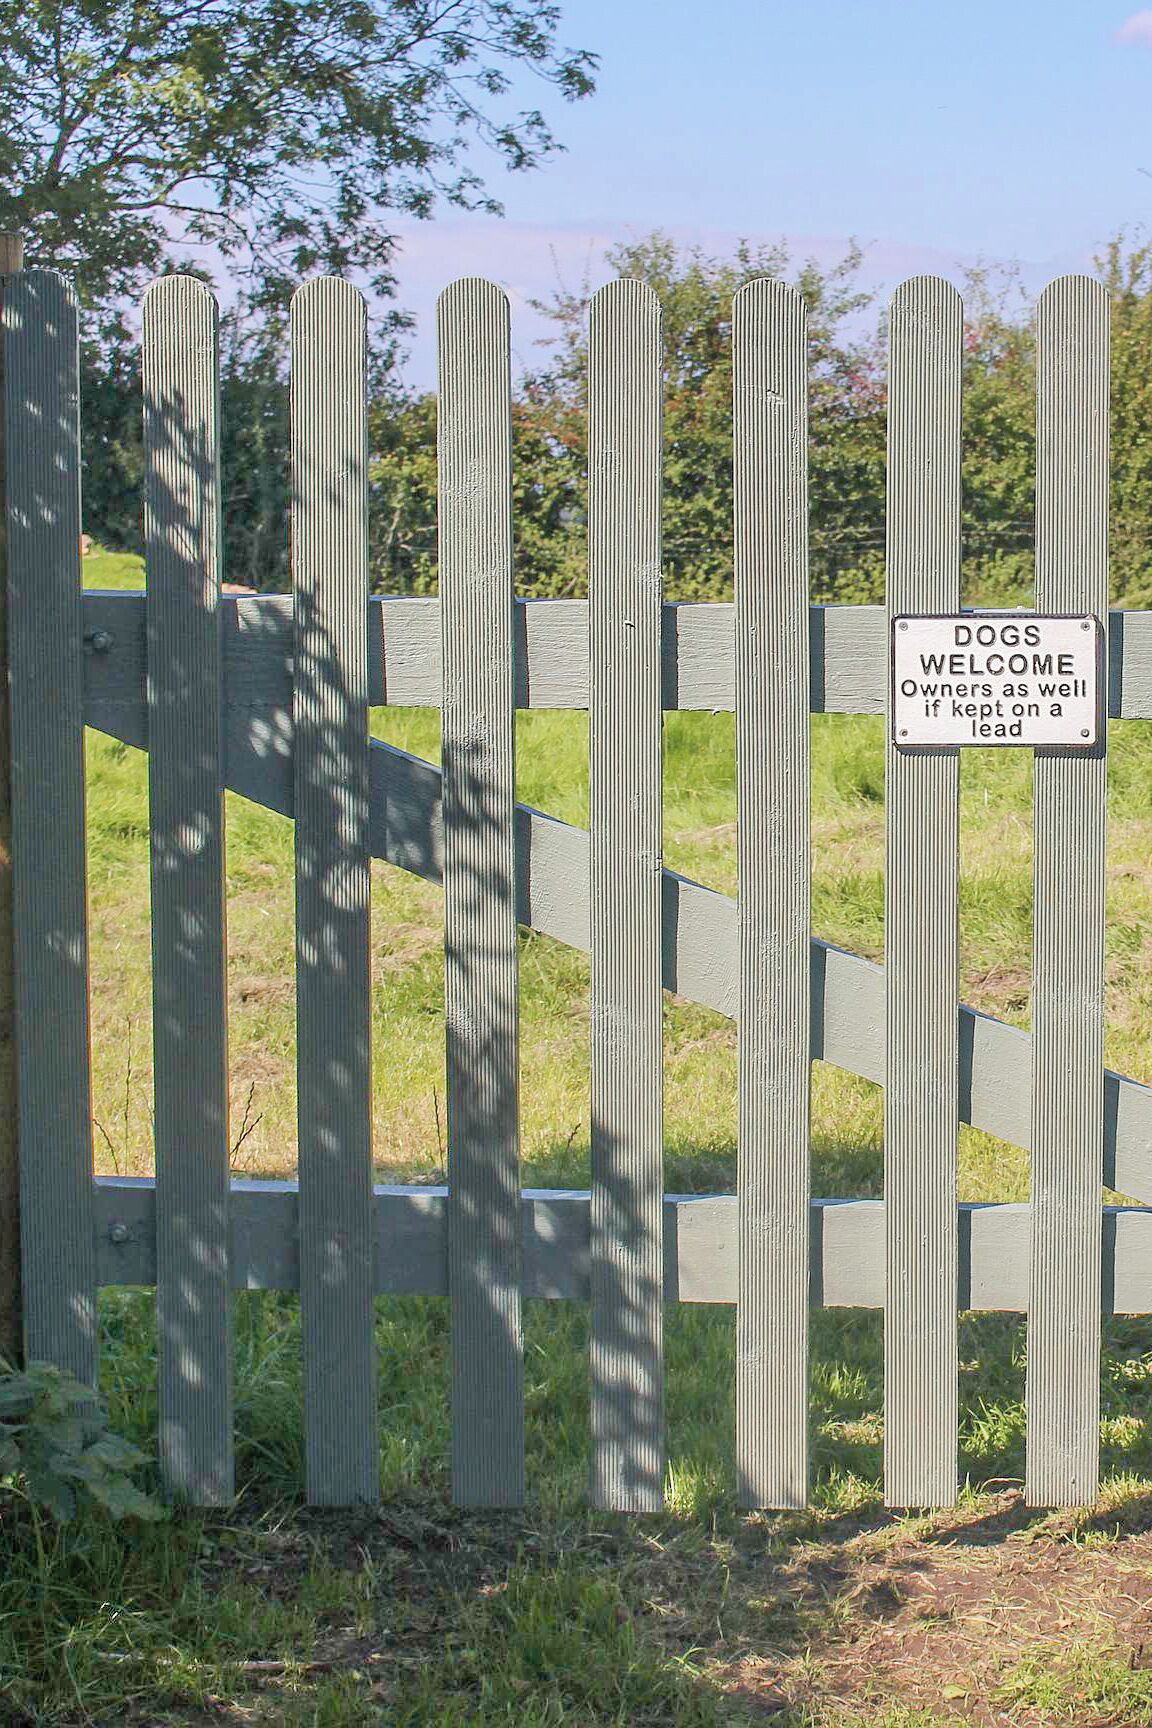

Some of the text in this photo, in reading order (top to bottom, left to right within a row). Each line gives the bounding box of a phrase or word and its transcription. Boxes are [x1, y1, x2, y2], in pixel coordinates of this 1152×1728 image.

[955, 625, 1041, 647] DOGS
[920, 654, 1075, 675] WELCOME
[901, 679, 1086, 697] Owners as well
[924, 700, 1063, 720] if kept on a
[972, 719, 1023, 737] lead
